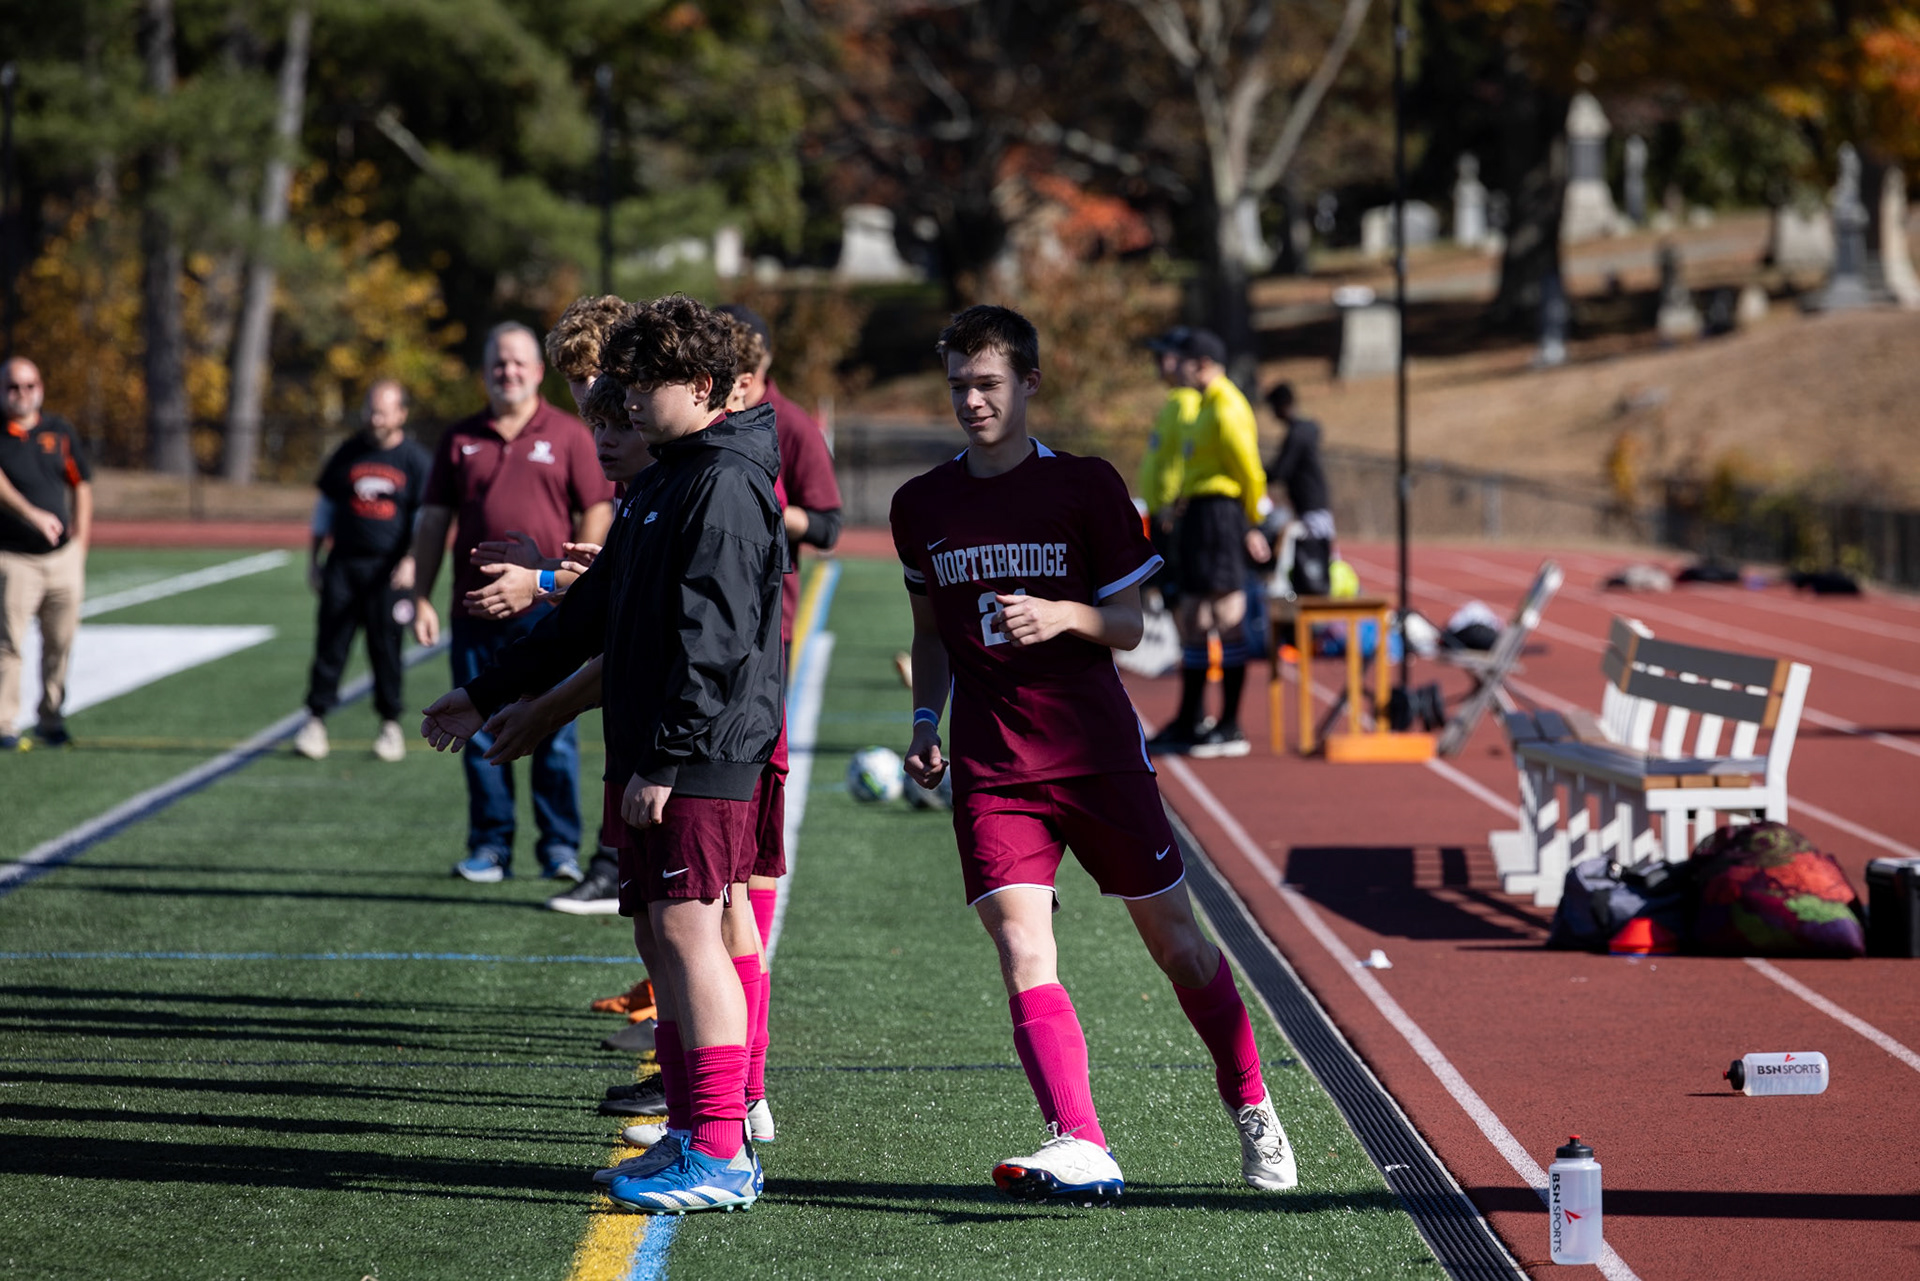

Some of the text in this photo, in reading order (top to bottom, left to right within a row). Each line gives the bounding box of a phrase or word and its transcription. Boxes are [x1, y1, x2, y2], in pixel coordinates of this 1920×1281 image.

[932, 543, 1067, 587] NORTHBRIDGE
[978, 588, 1027, 646] 2
[1757, 1064, 1822, 1075] BSN SPORTS
[1552, 1173, 1562, 1254] BSN SPORTS
